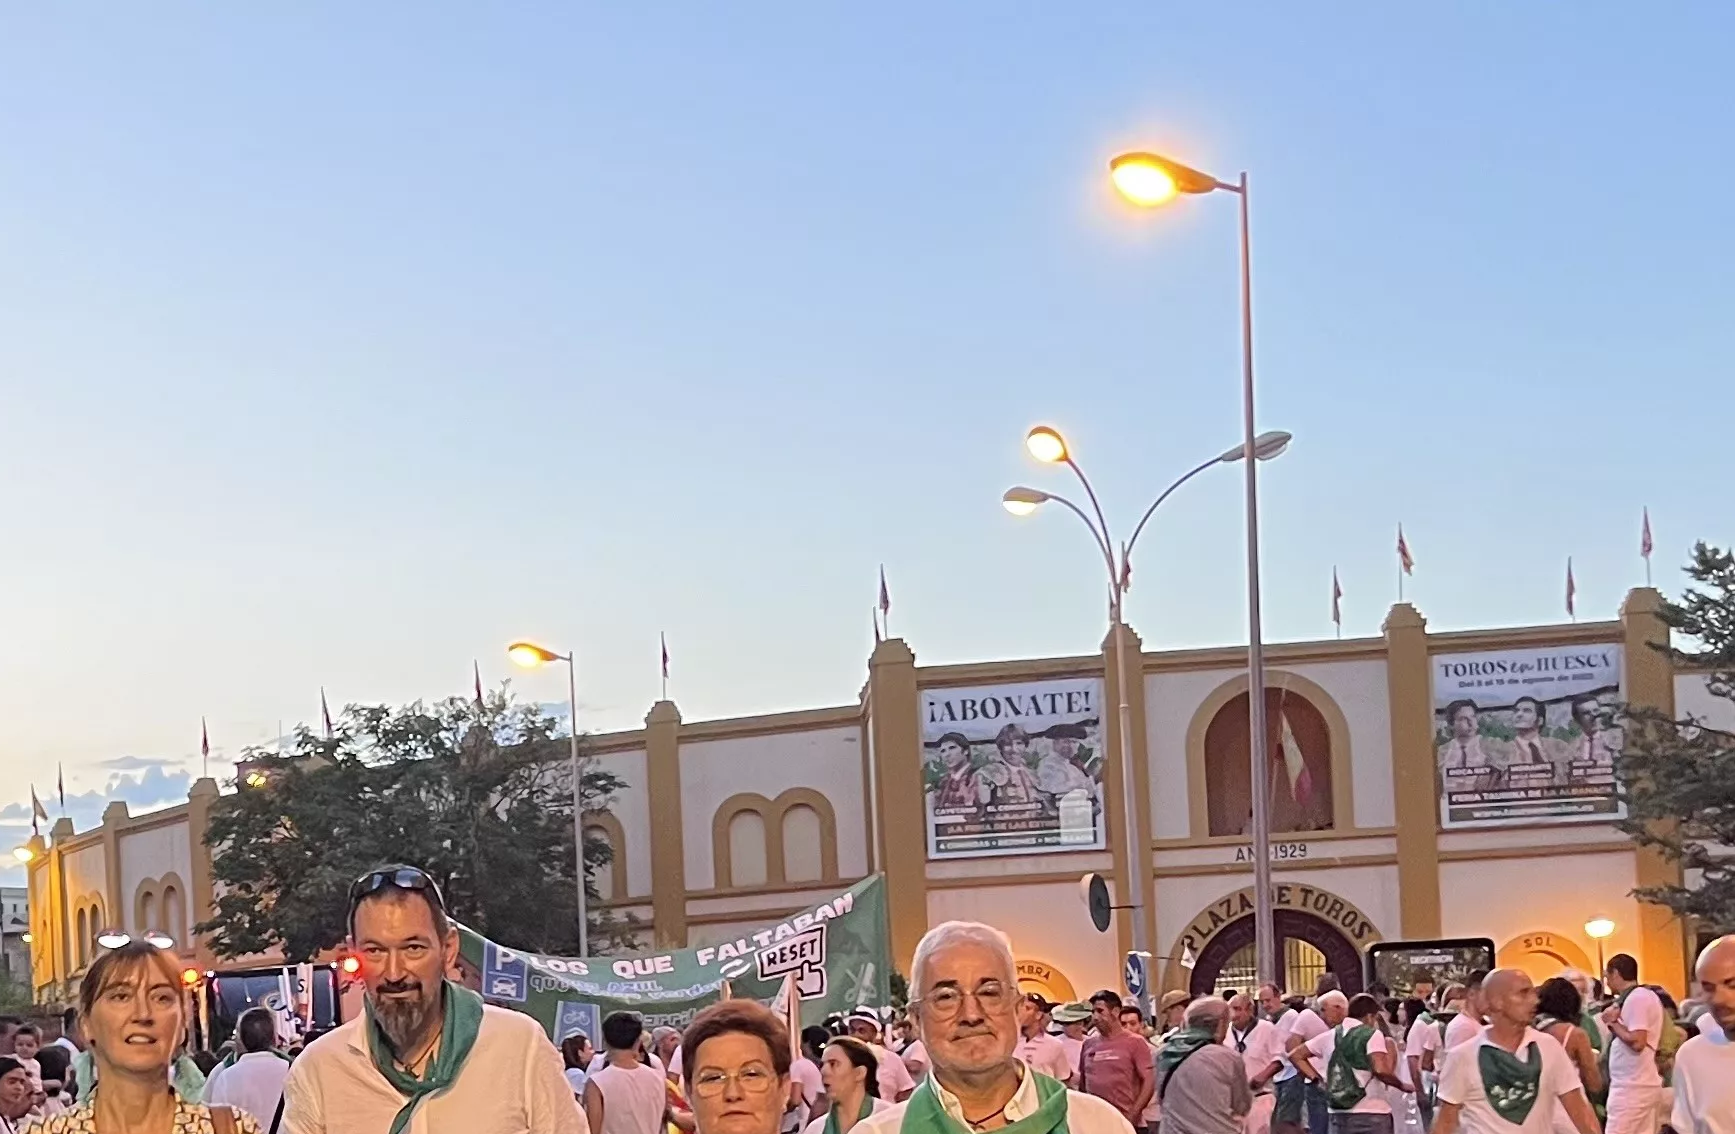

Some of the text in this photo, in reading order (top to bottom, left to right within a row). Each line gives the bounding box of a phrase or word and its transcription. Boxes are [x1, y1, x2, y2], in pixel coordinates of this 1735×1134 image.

[1440, 660, 1507, 678] TOROS
[1537, 653, 1610, 672] HUESCA
[1274, 843, 1307, 859] 1929
[1180, 892, 1255, 952] PLAZA
[1300, 887, 1373, 940] TOROS
[528, 892, 854, 980] LOS QUE FALTABAN
[1523, 936, 1554, 949] SOL
[767, 938, 818, 968] RESET
[1015, 964, 1051, 981] MBRA
